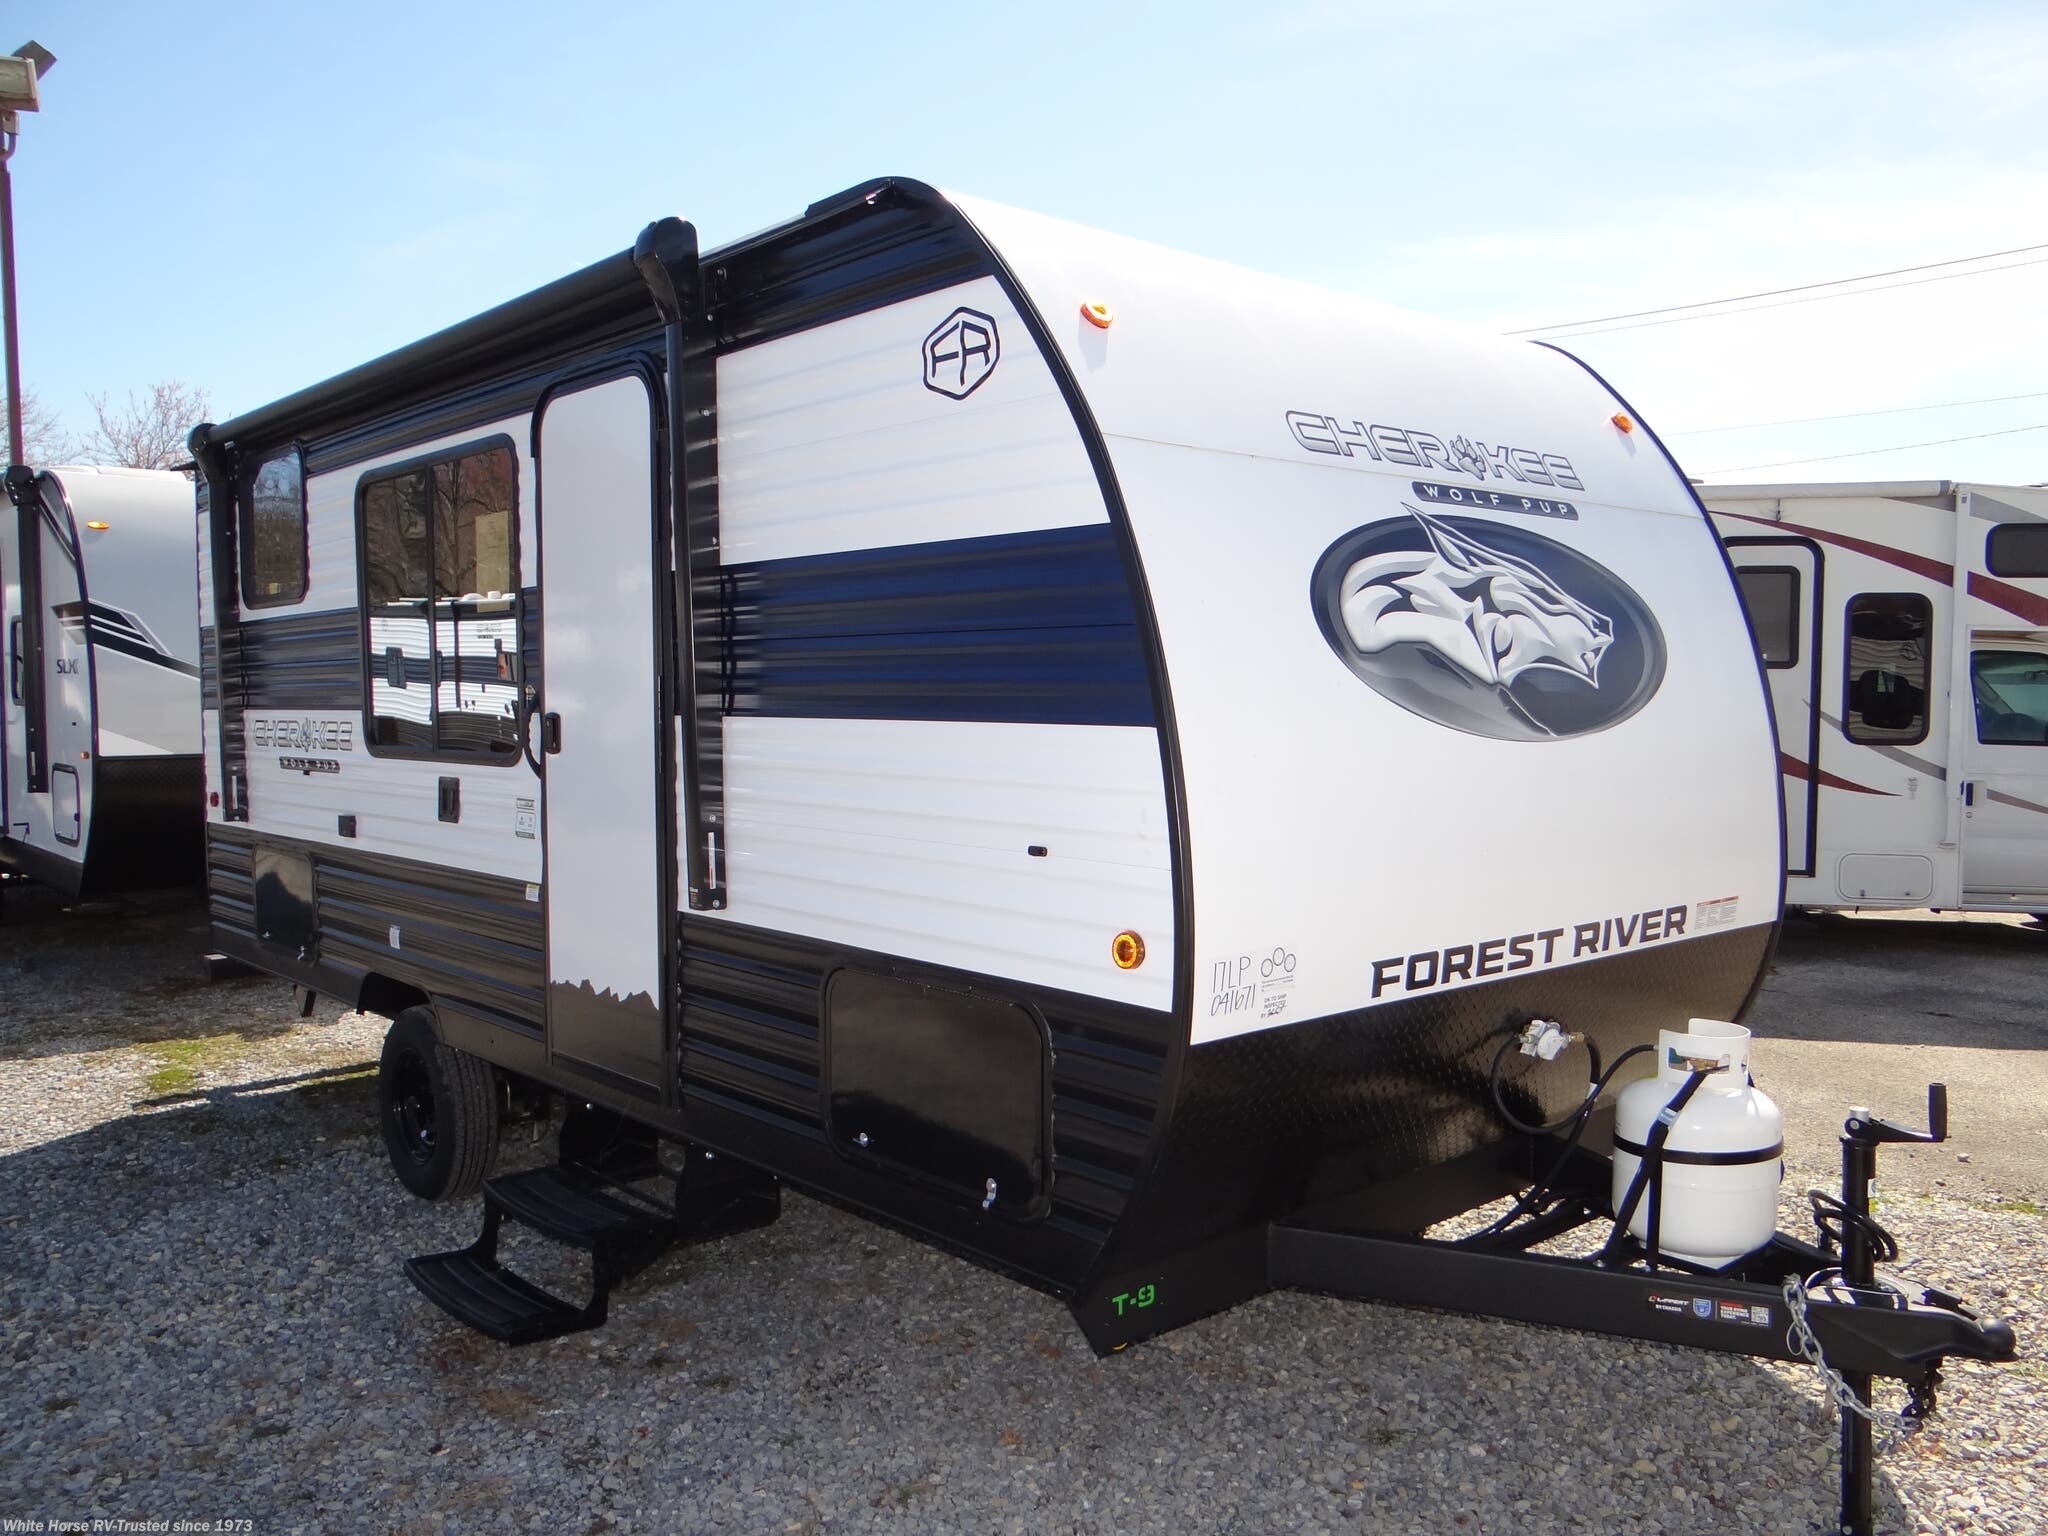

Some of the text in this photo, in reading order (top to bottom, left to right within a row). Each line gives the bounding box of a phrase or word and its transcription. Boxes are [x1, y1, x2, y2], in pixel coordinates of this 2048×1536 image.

[1423, 484, 1569, 516] WOLF PUP
[1370, 927, 1564, 999] FOREST
[1573, 904, 1687, 957] RIVER
[1112, 1284, 1154, 1316] T-9
